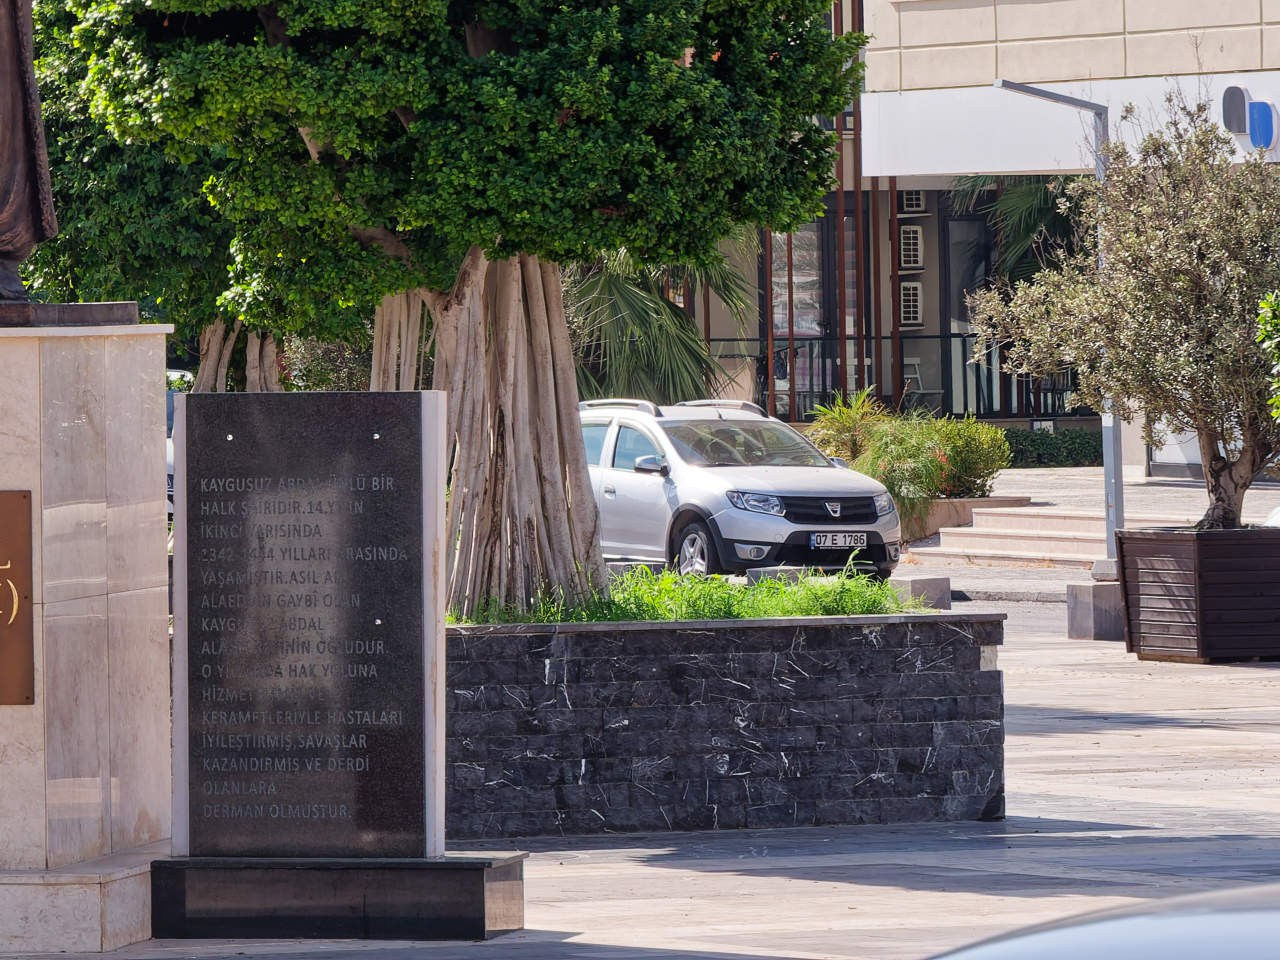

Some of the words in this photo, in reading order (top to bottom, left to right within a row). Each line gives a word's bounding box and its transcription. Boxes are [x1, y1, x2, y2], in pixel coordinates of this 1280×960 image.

[200, 478, 271, 492] KAYGUSUZ
[278, 477, 321, 491] ABD
[327, 474, 366, 491] ÜLÜ
[372, 476, 394, 490] BİR
[200, 502, 236, 515] HALK
[250, 523, 322, 538] ARISINDA
[815, 534, 828, 545] 07
[831, 534, 838, 545] E
[339, 547, 408, 561] RASINDA
[316, 637, 389, 655] OĞUDUR.
[201, 664, 212, 678] O
[288, 664, 315, 678] HAK
[304, 757, 321, 771] VE
[203, 781, 277, 795] OLANLARA
[203, 804, 264, 818] DERMAN
